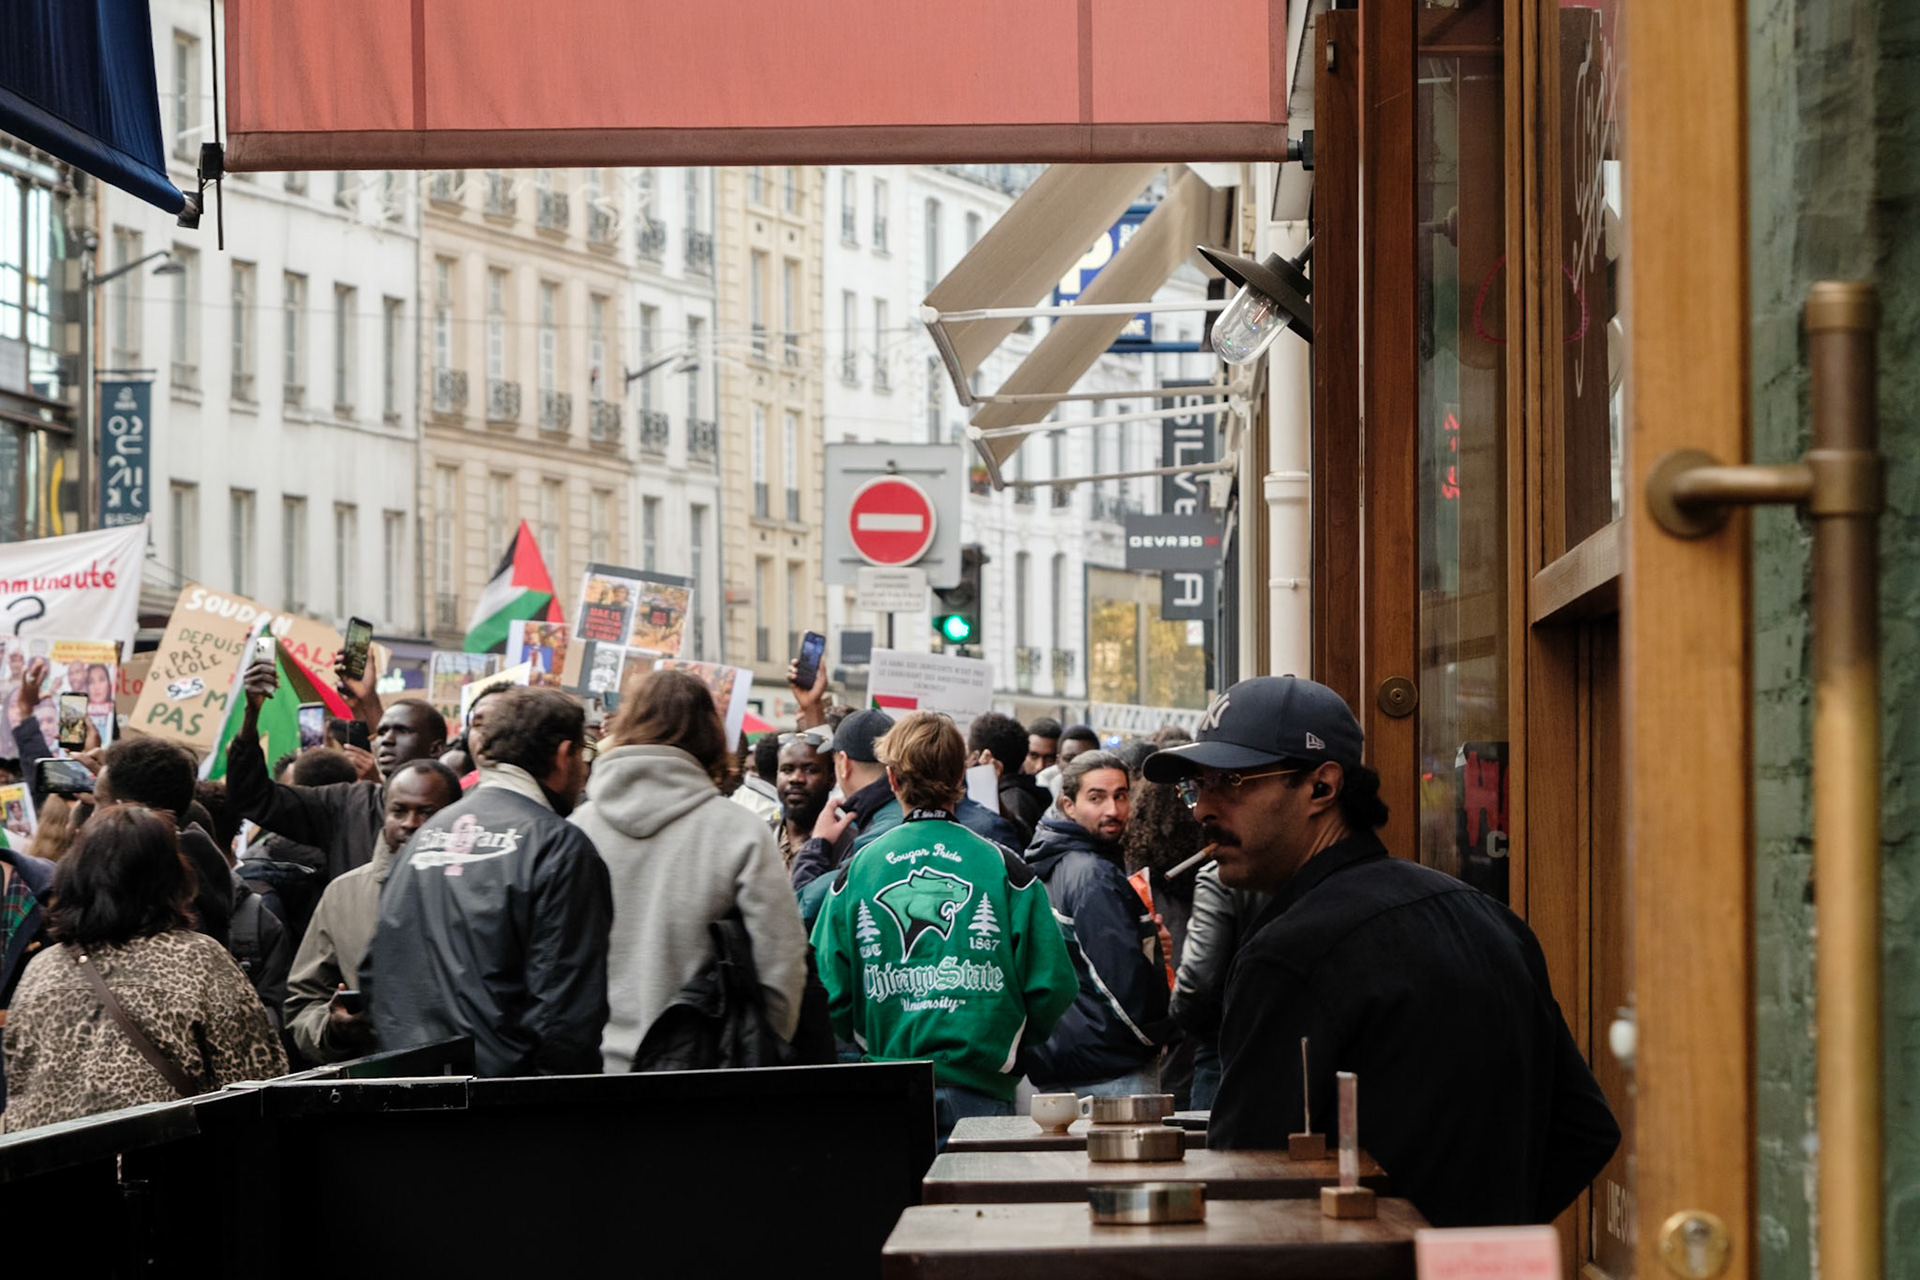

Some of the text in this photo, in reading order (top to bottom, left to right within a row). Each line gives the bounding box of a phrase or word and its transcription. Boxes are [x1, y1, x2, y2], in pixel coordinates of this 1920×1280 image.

[169, 645, 203, 667] PAS
[147, 702, 204, 737] PAS
[885, 843, 963, 865] Cougar Pride
[968, 936, 1001, 951] 1867
[863, 955, 1005, 1004] Chicago State
